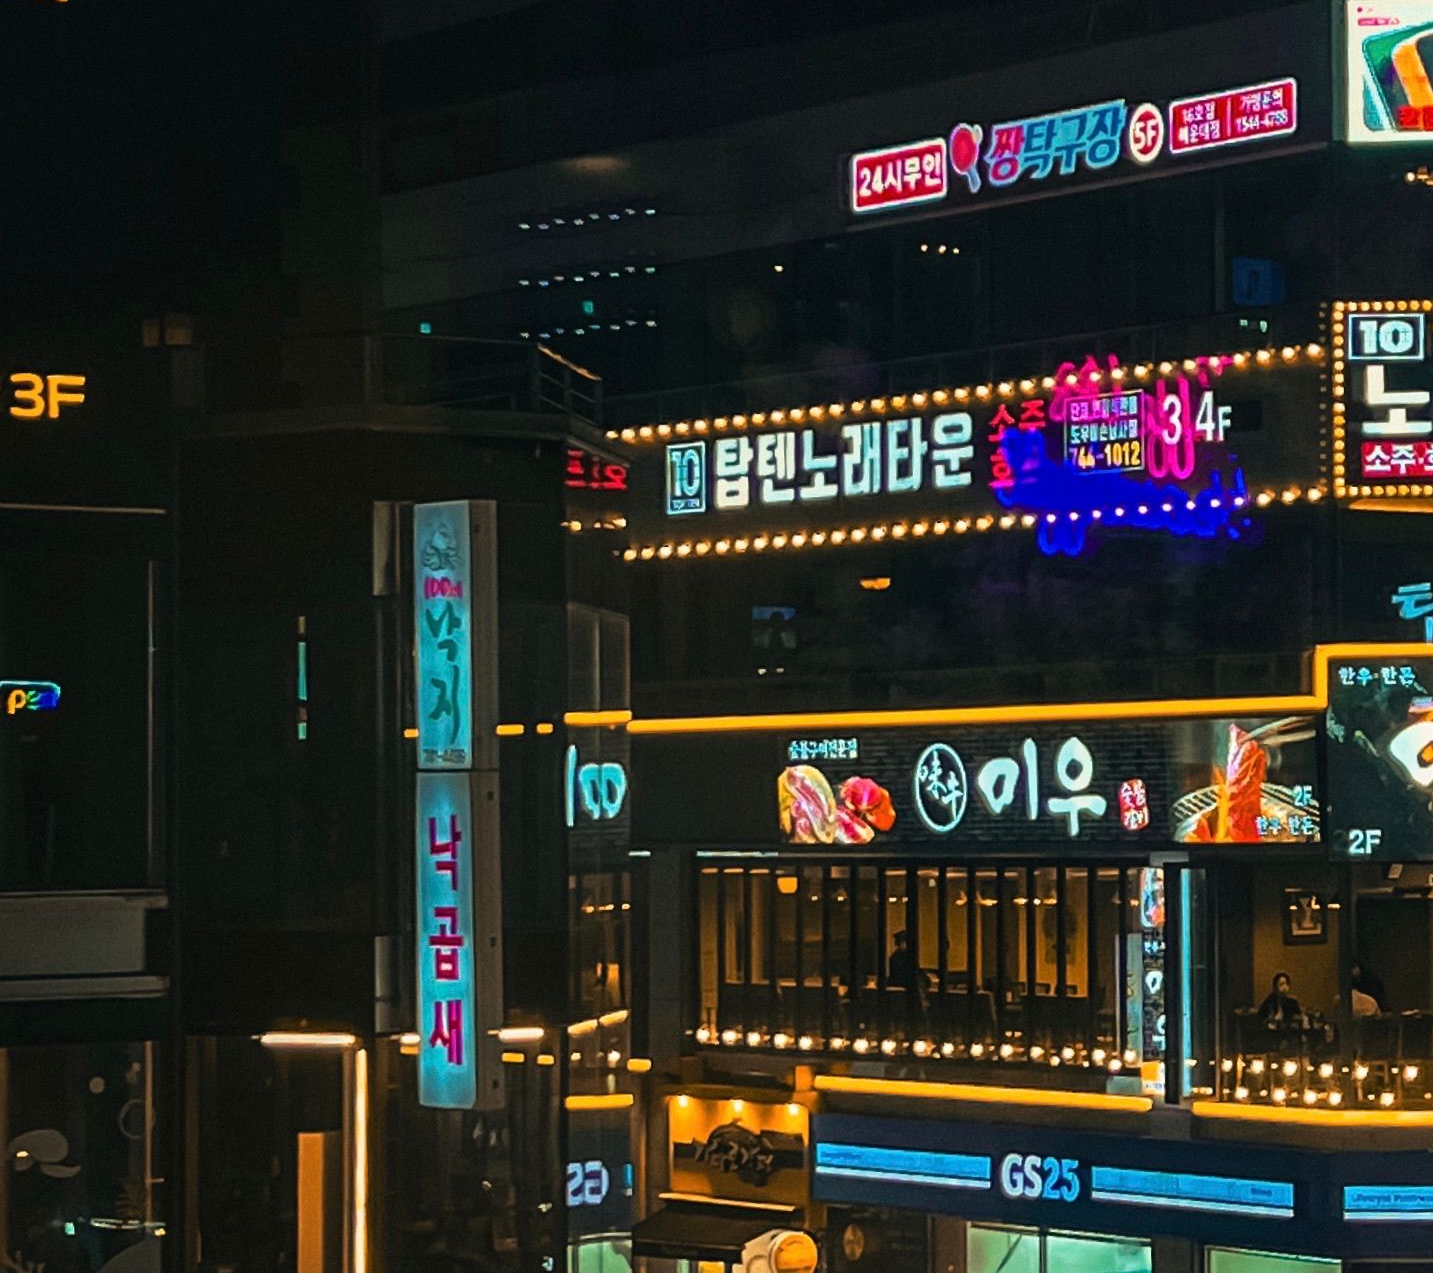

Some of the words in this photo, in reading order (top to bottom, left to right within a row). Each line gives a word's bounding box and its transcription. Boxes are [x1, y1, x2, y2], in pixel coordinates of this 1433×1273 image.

[986, 101, 1127, 186] 짱탁구장
[1133, 118, 1158, 148] 5F
[858, 149, 942, 200] 24시무인
[1359, 321, 1414, 354] 10
[9, 372, 86, 420] 3F
[670, 449, 701, 497] 10
[714, 412, 973, 510] 탑텐노래타운
[425, 601, 462, 744] 낙지
[978, 737, 1106, 836] 미우
[1293, 785, 1311, 805] 2F
[1348, 830, 1382, 855] 2F
[1001, 1153, 1080, 1201] GS25
